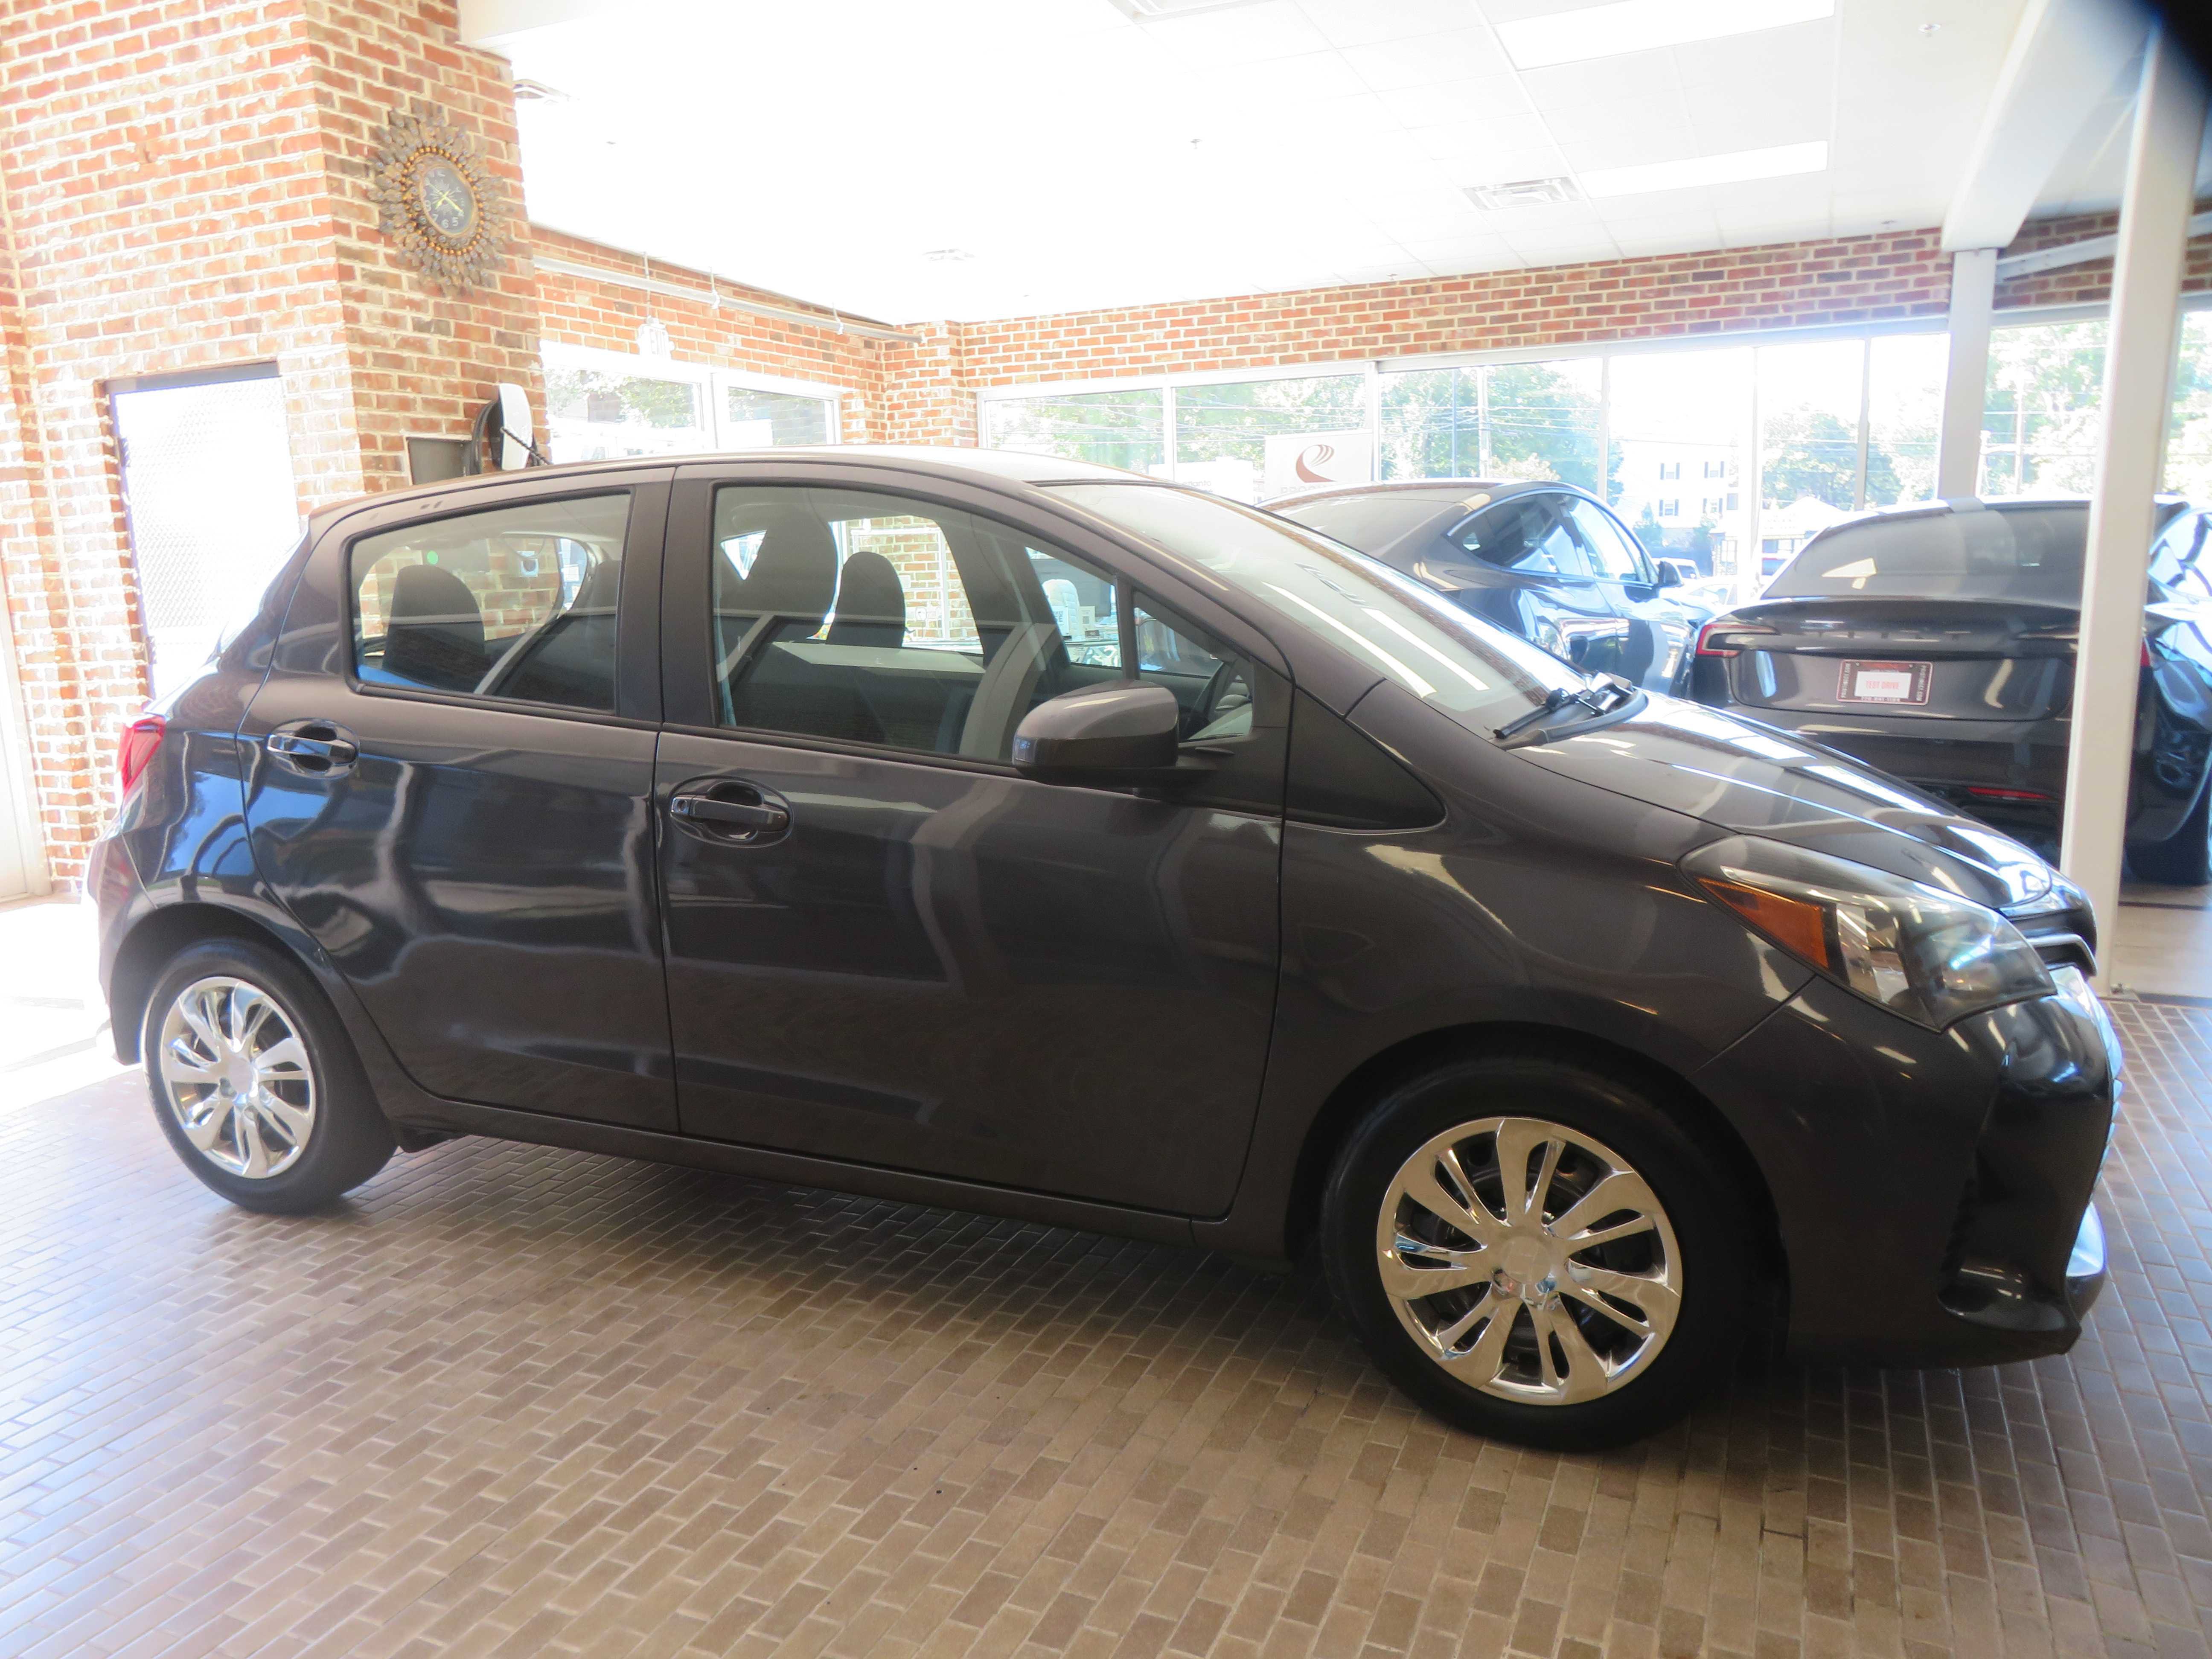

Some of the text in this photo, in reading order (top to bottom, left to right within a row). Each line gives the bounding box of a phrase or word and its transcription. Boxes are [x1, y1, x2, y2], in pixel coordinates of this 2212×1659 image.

[441, 219, 449, 228] 6
[452, 217, 459, 226] 5
[1866, 681, 1899, 690] TEST DRIVE
